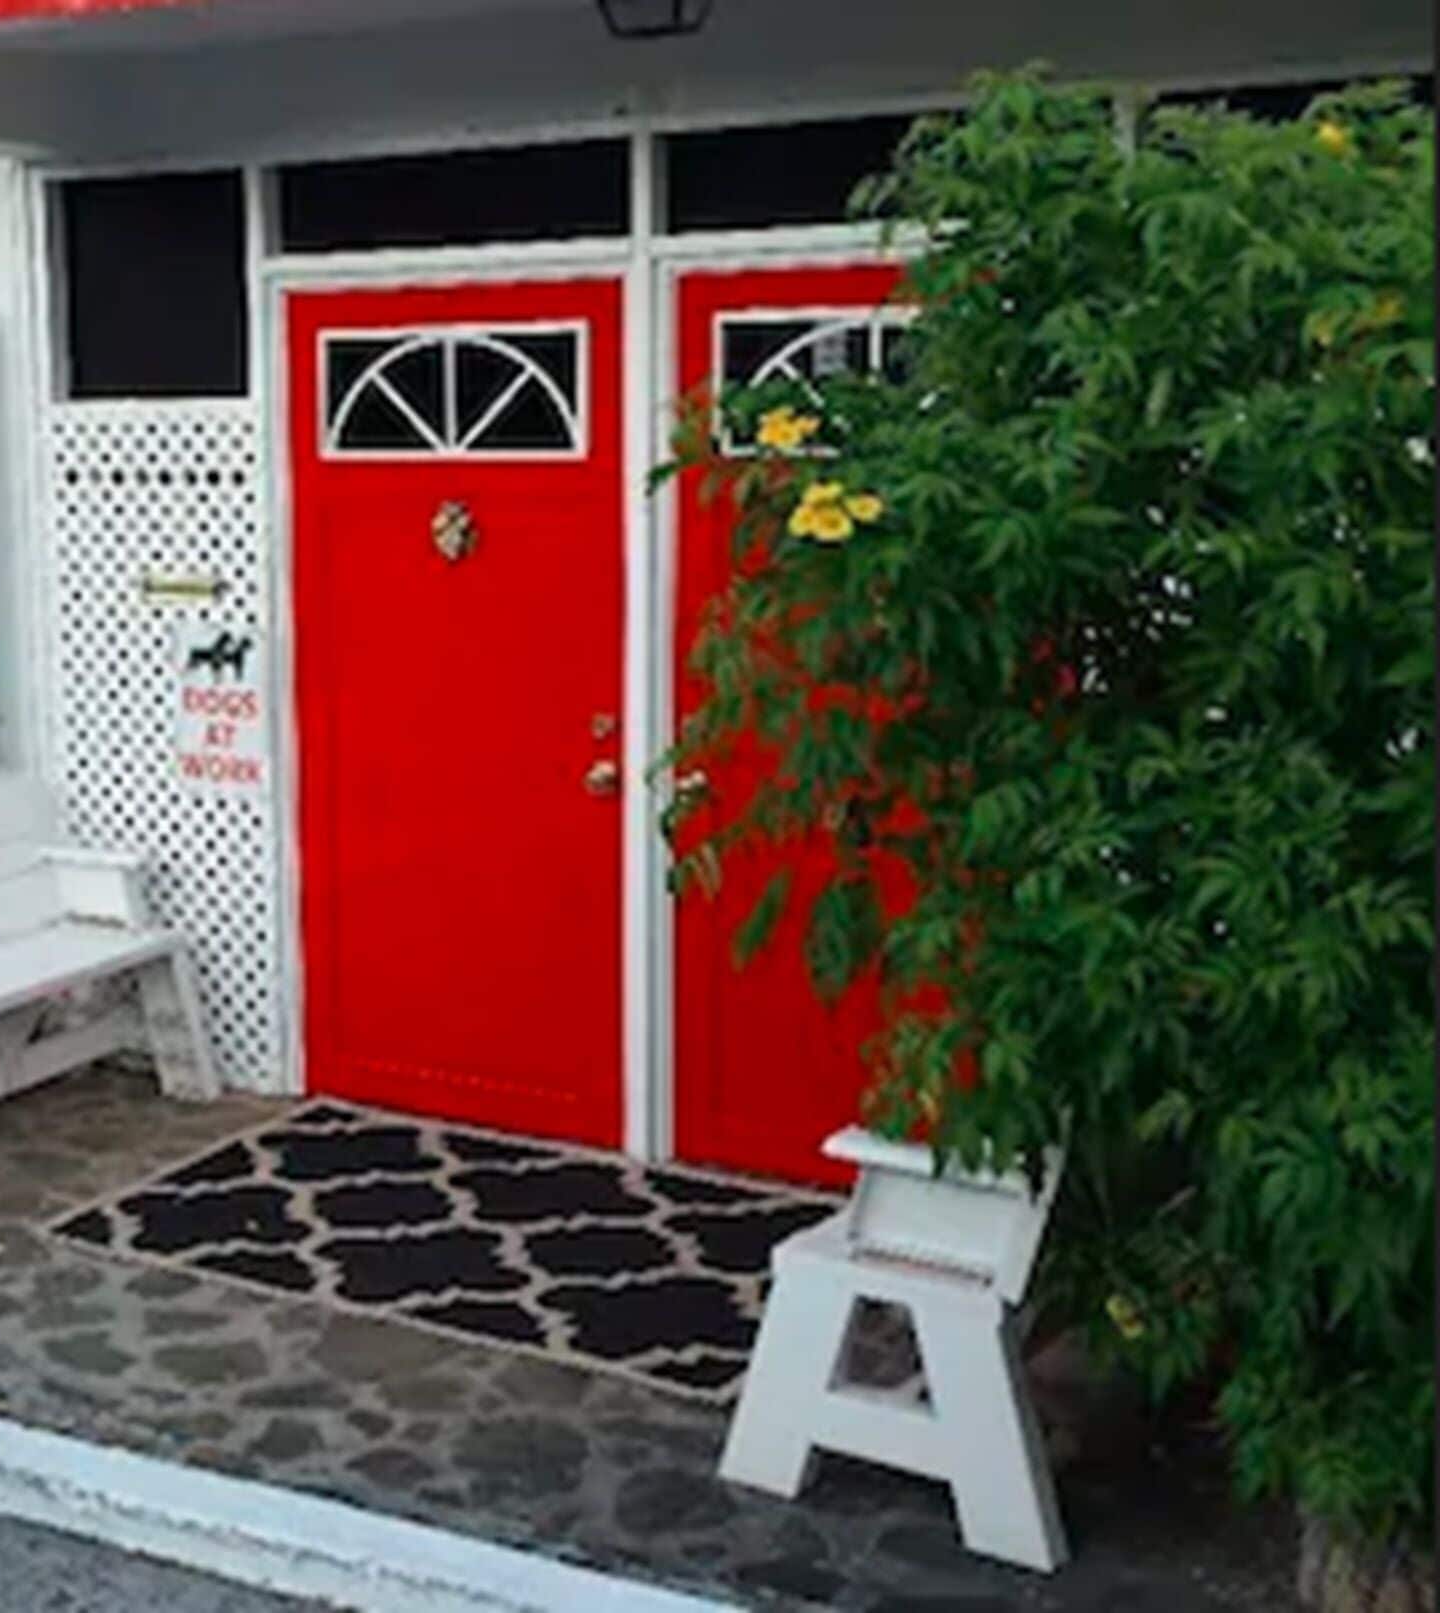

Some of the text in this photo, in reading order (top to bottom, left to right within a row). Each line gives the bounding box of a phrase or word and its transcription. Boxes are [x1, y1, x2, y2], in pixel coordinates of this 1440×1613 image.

[182, 685, 258, 718] DOGS
[204, 721, 237, 746] AT
[179, 753, 264, 784] WORK
